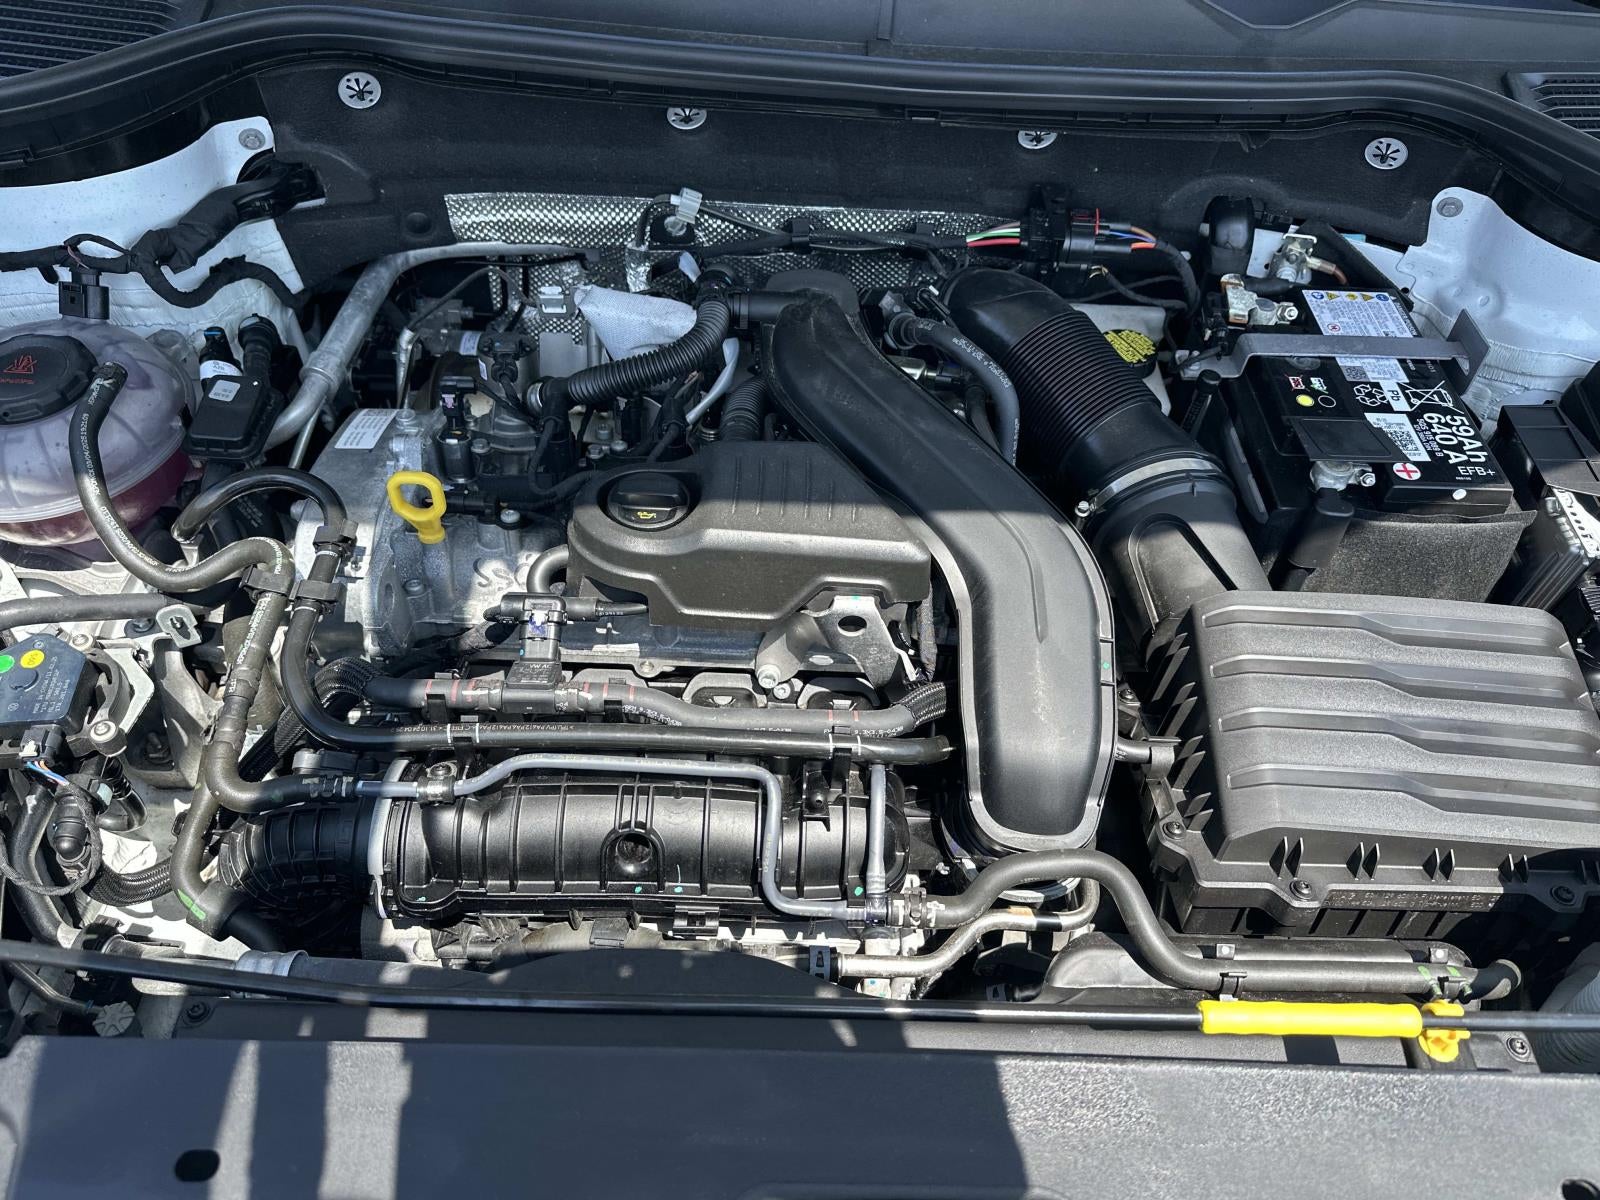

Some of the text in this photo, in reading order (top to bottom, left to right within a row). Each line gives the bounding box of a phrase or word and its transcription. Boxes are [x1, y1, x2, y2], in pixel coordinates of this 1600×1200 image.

[1387, 388, 1401, 402] Pb
[1423, 412, 1459, 445] 640
[1442, 449, 1469, 464] A
[1445, 414, 1489, 463] 59Ah
[1457, 465, 1496, 476] EFB+
